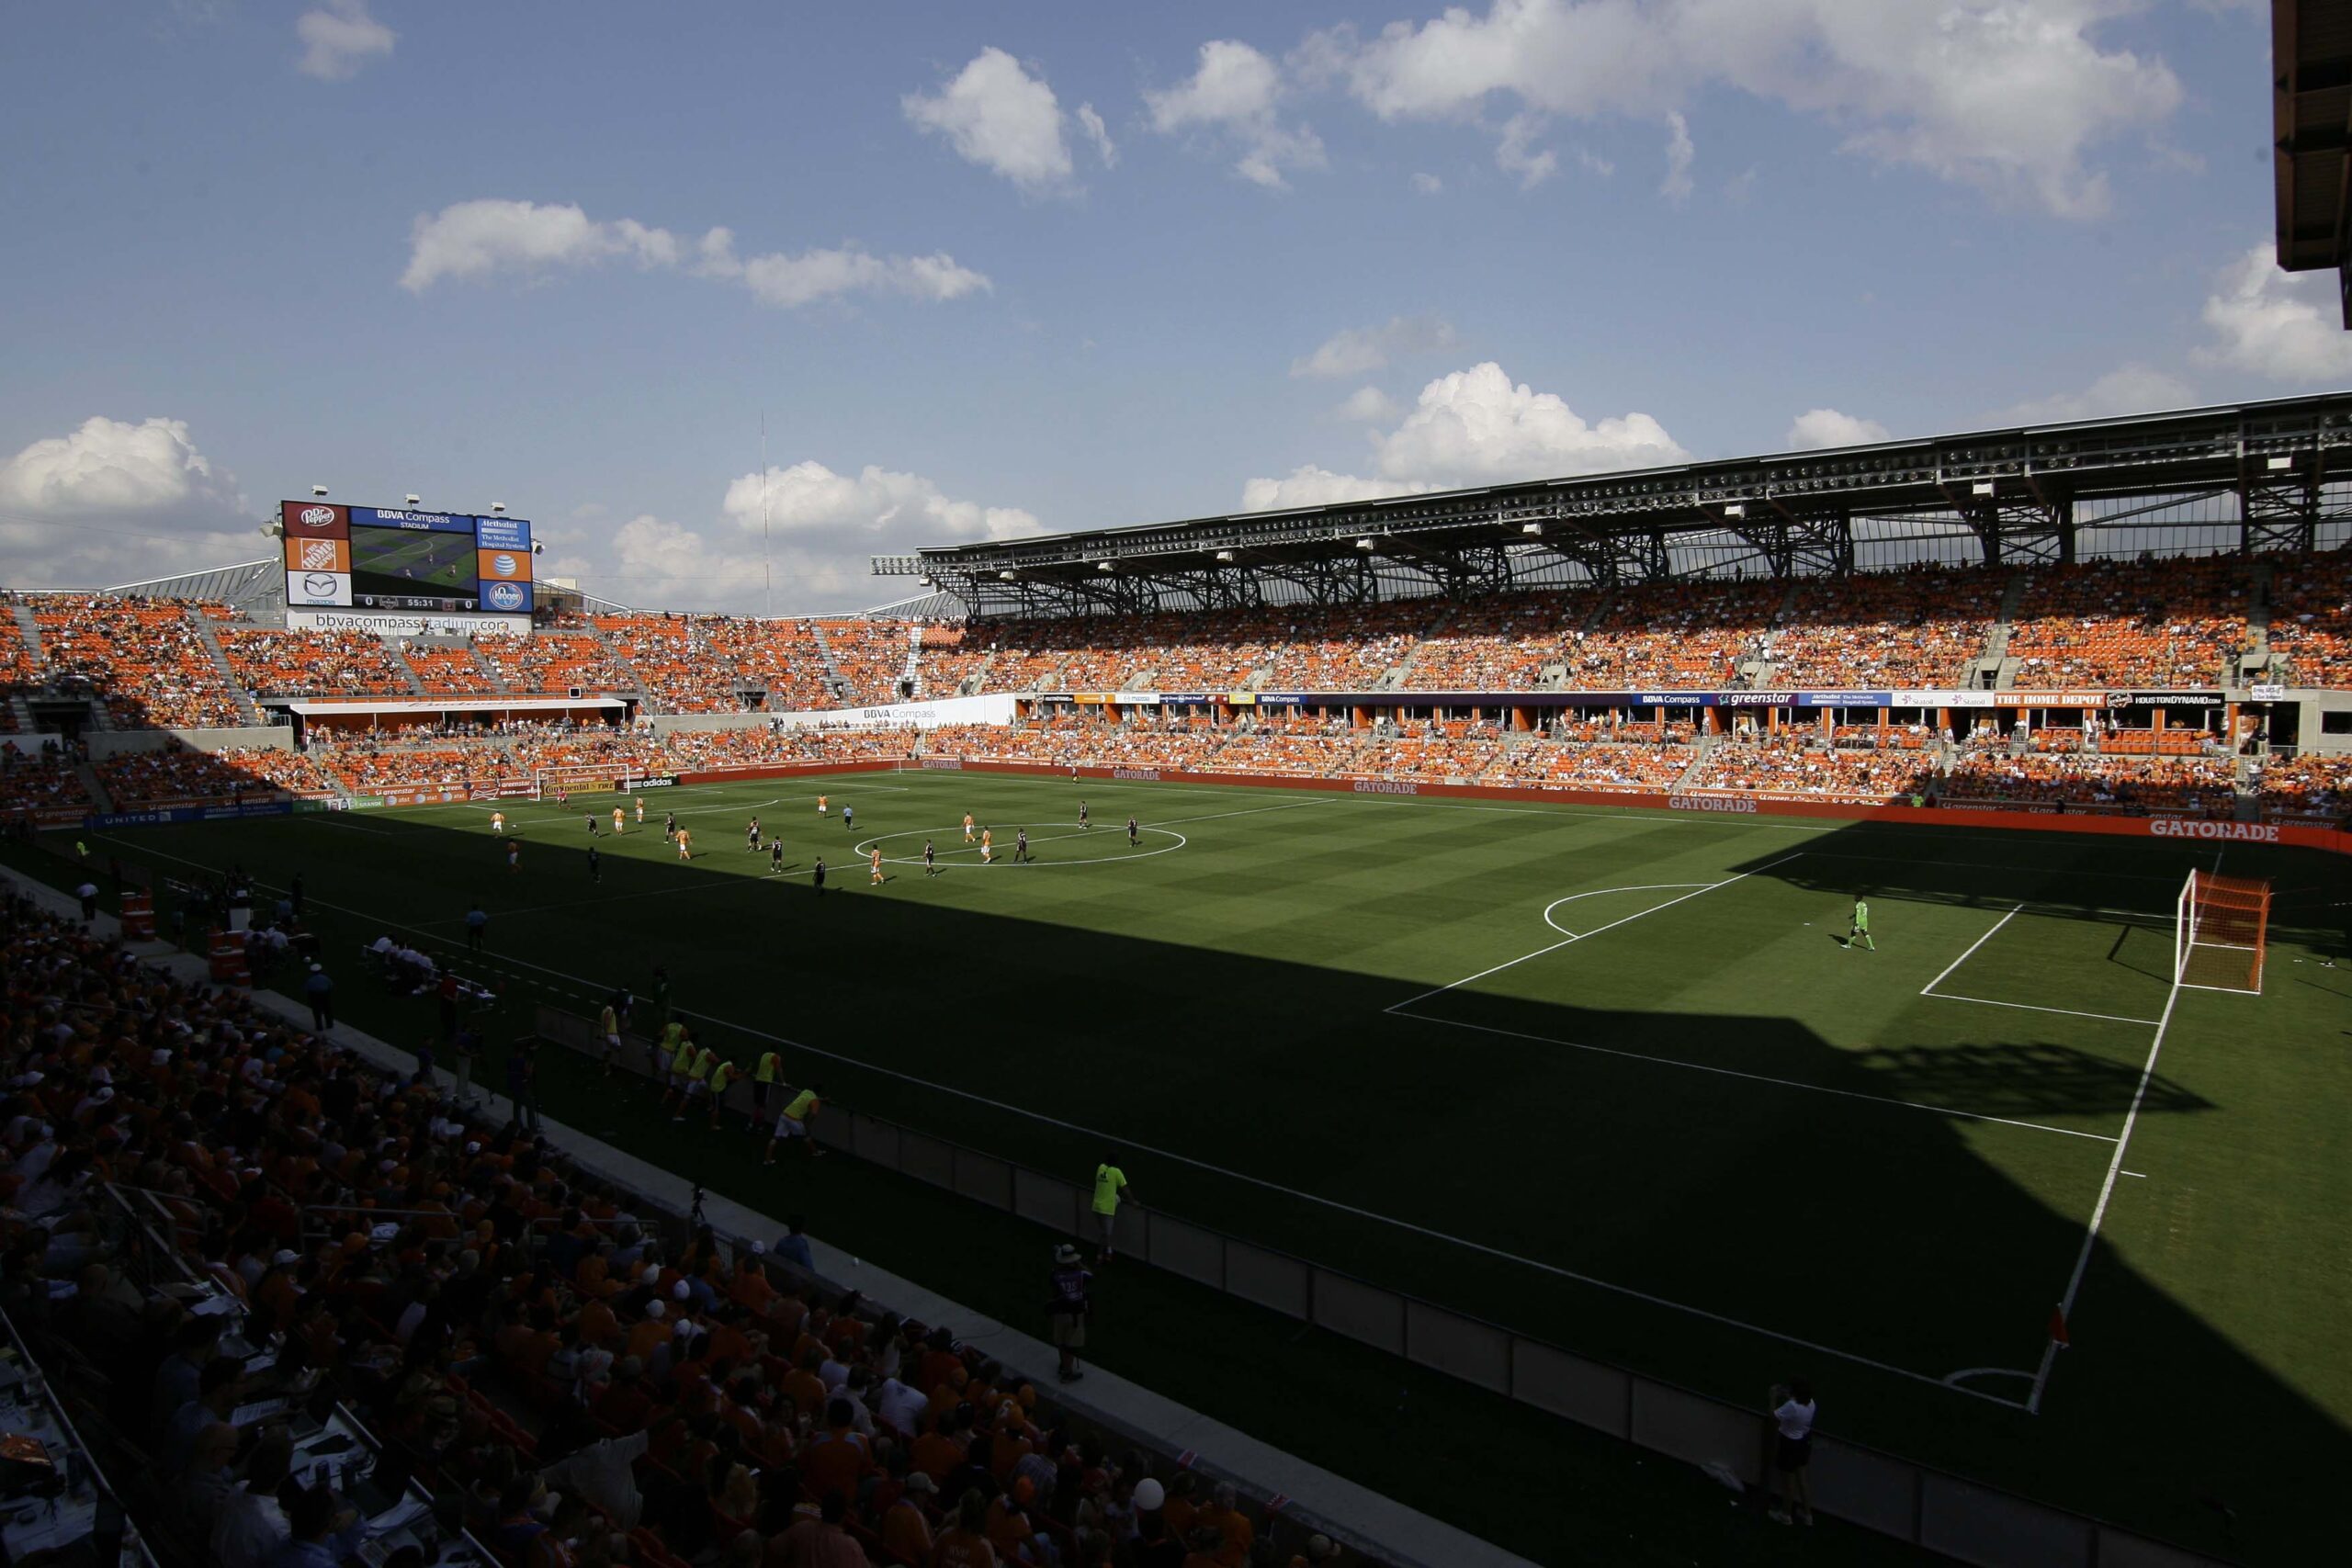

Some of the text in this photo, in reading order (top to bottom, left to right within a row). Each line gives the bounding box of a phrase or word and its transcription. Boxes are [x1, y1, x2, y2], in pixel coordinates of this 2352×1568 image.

[304, 510, 331, 524] Pepper
[377, 510, 450, 524] BBVA Compass
[400, 522, 429, 530] STADIUM
[481, 520, 518, 528] Methodist
[306, 543, 318, 554] THE
[303, 541, 334, 569] HOME
[315, 553, 334, 569] DEPOT
[365, 597, 373, 605] 0
[494, 587, 520, 605] Kroger
[465, 600, 472, 609] 0
[316, 614, 510, 631] bbvacompasstadium.com
[1275, 695, 1300, 704] Compass
[1664, 695, 1701, 705] Compass
[1731, 693, 1792, 705] greenstar
[1996, 695, 2103, 705] THE HOME DEPOT
[2135, 696, 2221, 705] HOUSTONDYNAMO.COM
[864, 708, 936, 719] BBVA Compass
[922, 760, 962, 770] GATORADE
[1114, 769, 1160, 781] GATORADE
[643, 778, 672, 787] adidas
[1353, 781, 1418, 795] GATORADE
[1668, 796, 1757, 813] GATORADE
[105, 814, 157, 825] UNITED
[2150, 819, 2279, 841] GATORADE
